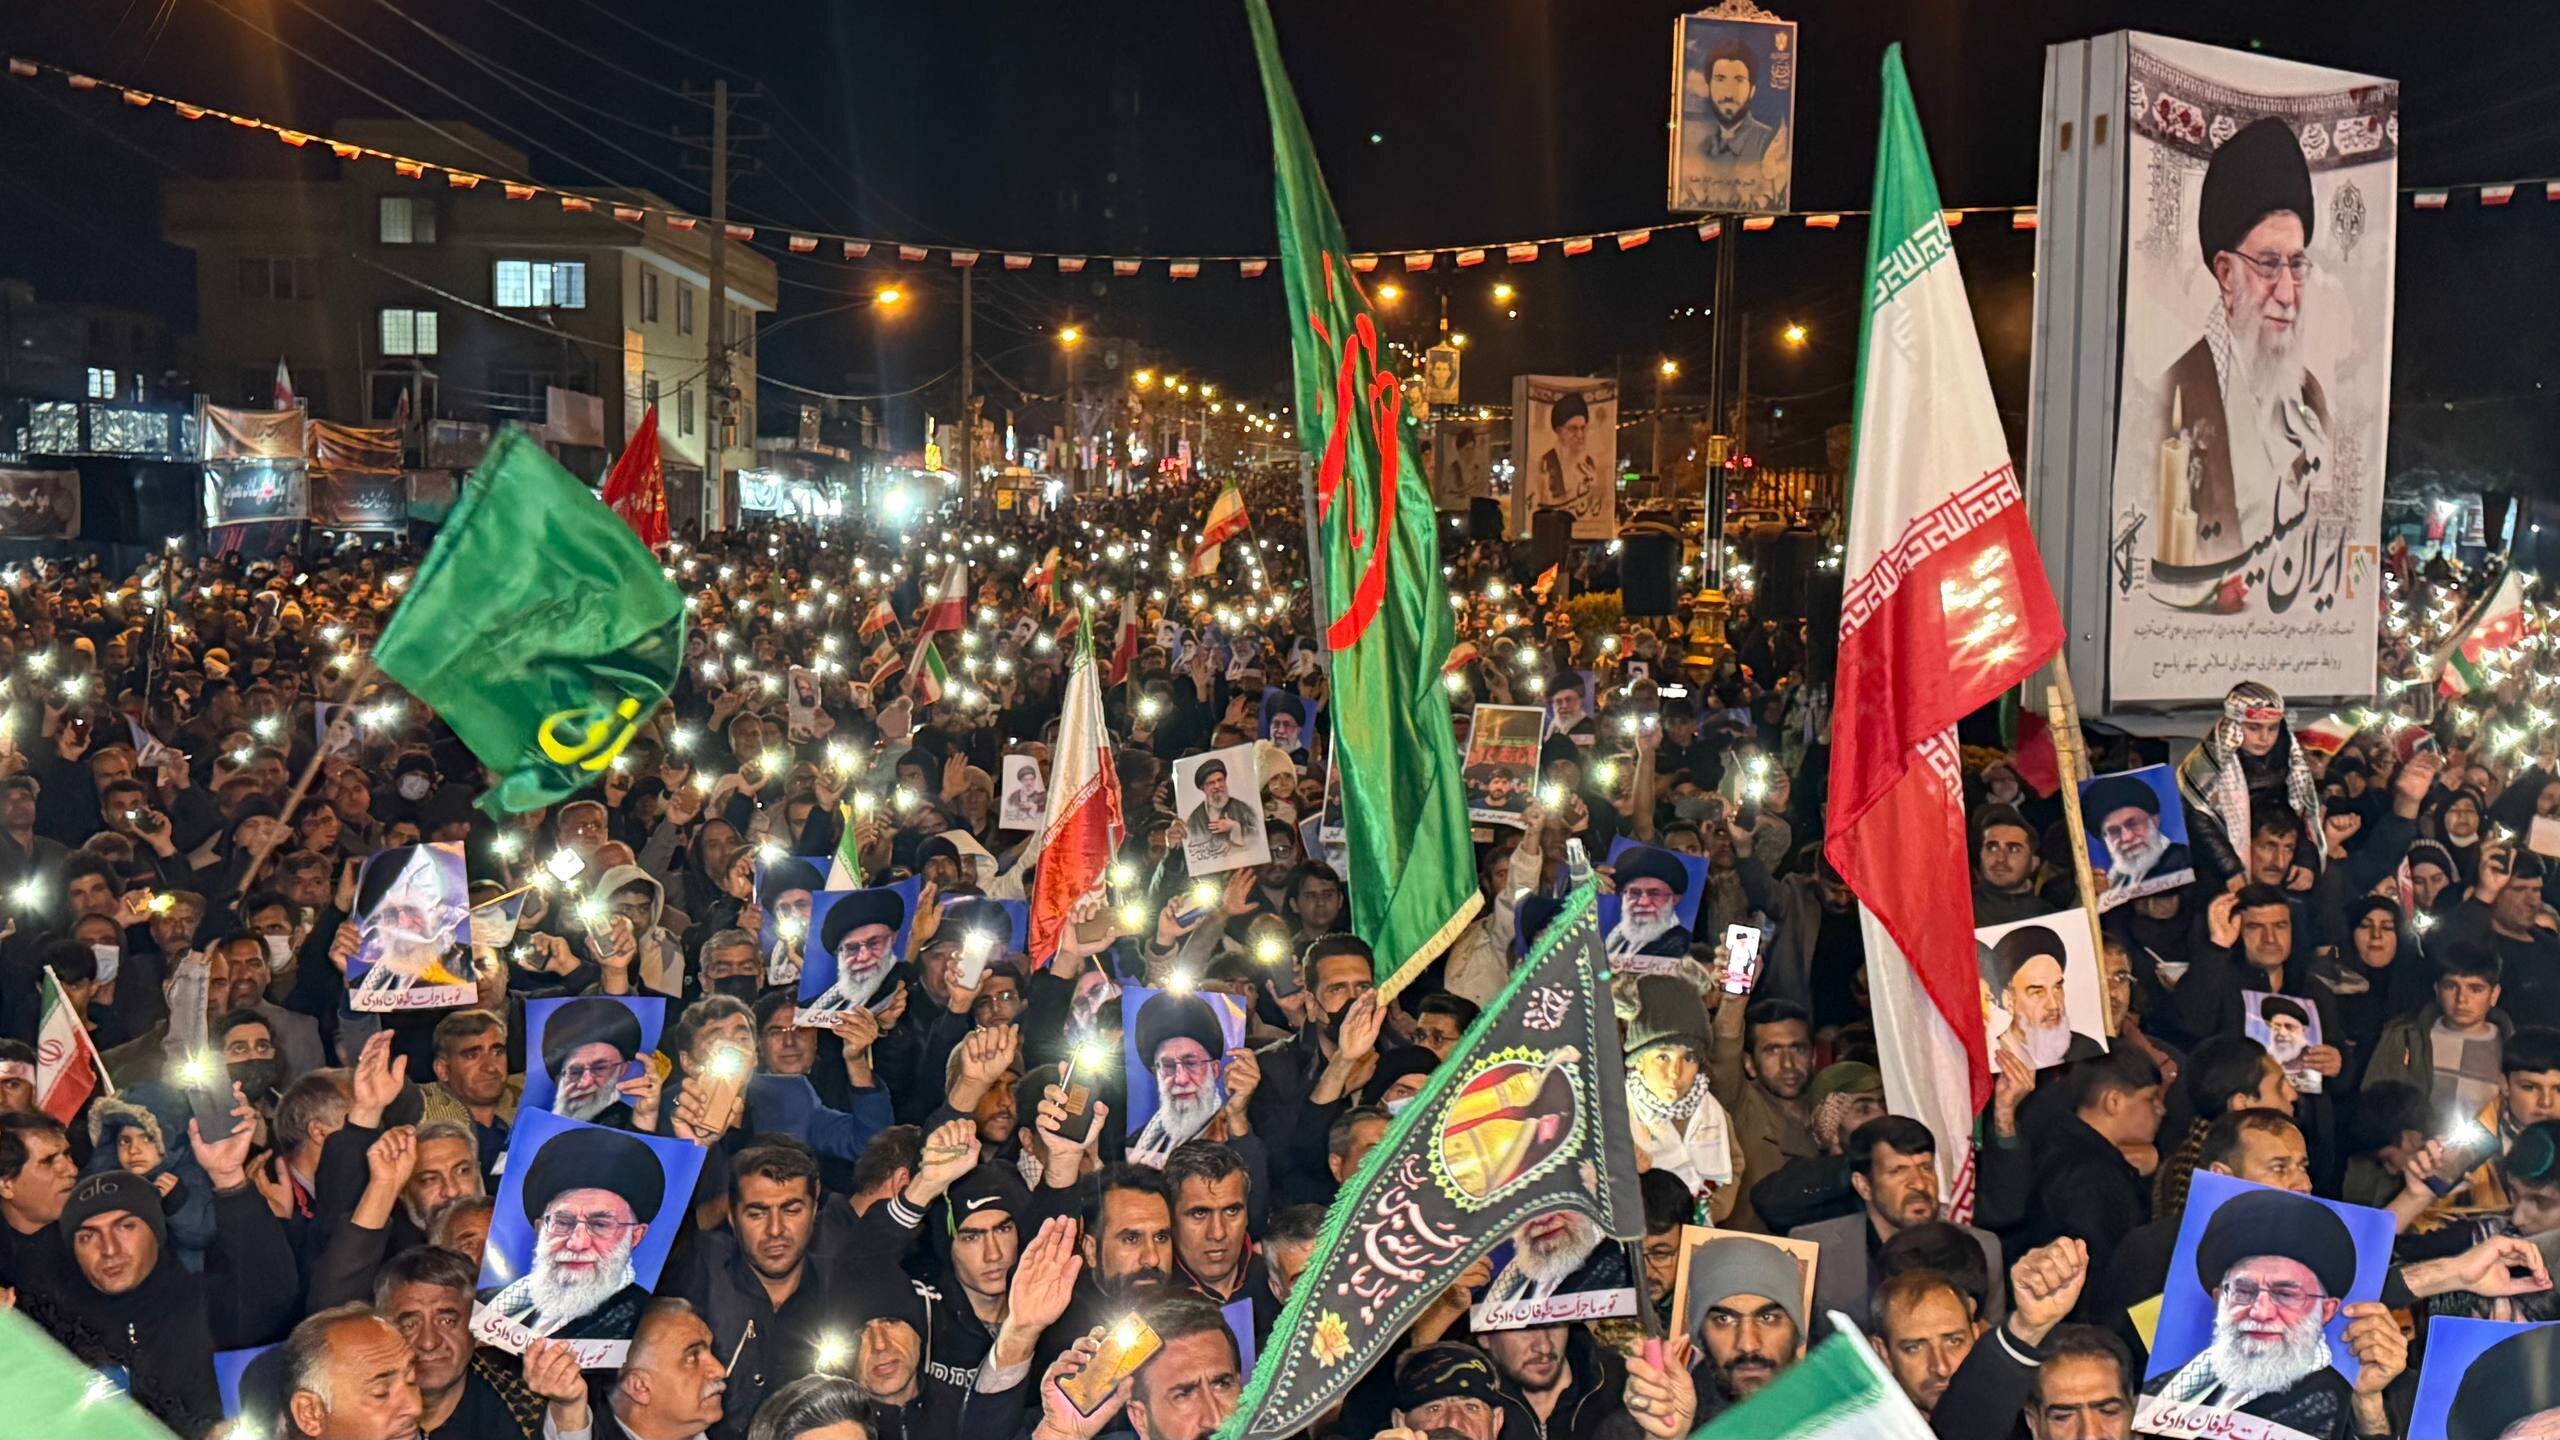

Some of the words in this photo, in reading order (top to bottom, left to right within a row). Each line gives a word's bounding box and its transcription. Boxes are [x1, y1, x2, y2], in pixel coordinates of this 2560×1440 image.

[2150, 456, 2321, 588] تسلیت
[2266, 517, 2346, 614] ایران
[2152, 651, 2180, 679] یاسوج
[2181, 656, 2198, 675] شهر
[2199, 651, 2229, 675] اسلامی
[2257, 651, 2292, 673] شهرداری
[2292, 657, 2319, 673] عمومی
[2321, 650, 2342, 671] روابط
[79, 1177, 119, 1202] alo
[1485, 1304, 1514, 1325] دادی
[484, 1317, 511, 1342] دادی
[2152, 1405, 2186, 1430] دادی
[2186, 1411, 2235, 1433] طوفان
